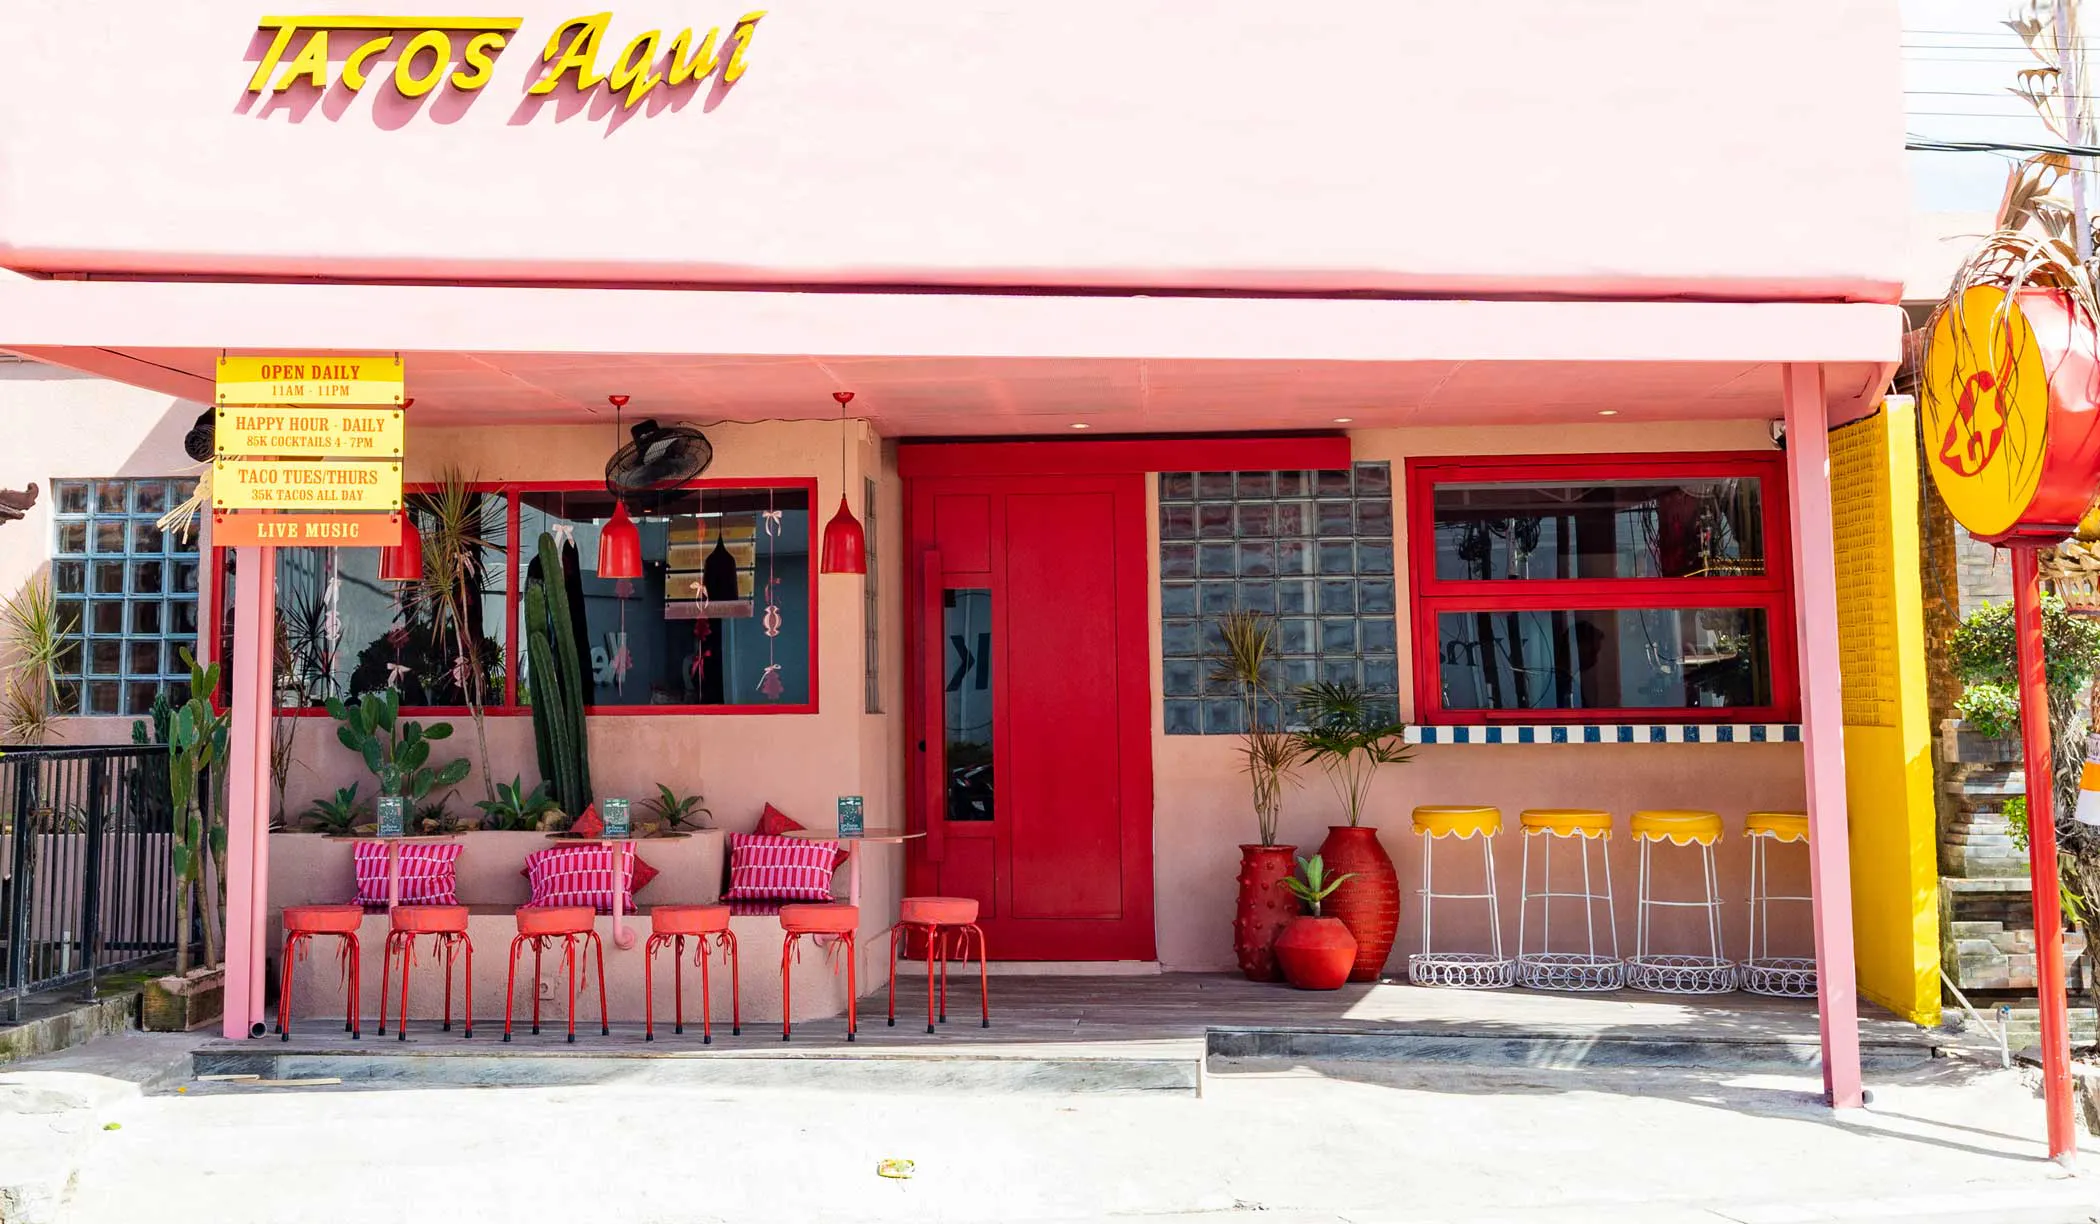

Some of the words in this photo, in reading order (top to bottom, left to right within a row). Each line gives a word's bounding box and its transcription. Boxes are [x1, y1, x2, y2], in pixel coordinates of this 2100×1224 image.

[247, 15, 524, 98] TACOS
[261, 364, 304, 380] OPEN
[311, 365, 360, 380] DAILY
[272, 385, 304, 396] 11AM
[318, 385, 350, 397] 11PM
[235, 416, 284, 431] HAPPY
[289, 417, 329, 432] HOUR
[342, 418, 385, 433] DAILY
[246, 435, 267, 447] 85K
[271, 435, 332, 447] COCKTAILS
[334, 437, 341, 448] 4
[350, 437, 373, 448] 7PM
[238, 469, 278, 484] TACO
[282, 469, 378, 485] TUES/THURS
[251, 489, 273, 501] 35K
[276, 489, 314, 501] TACOS
[317, 489, 338, 501] ALL
[341, 489, 364, 501] DAY
[257, 522, 298, 538] LIVE
[305, 522, 359, 538] MUSIC
